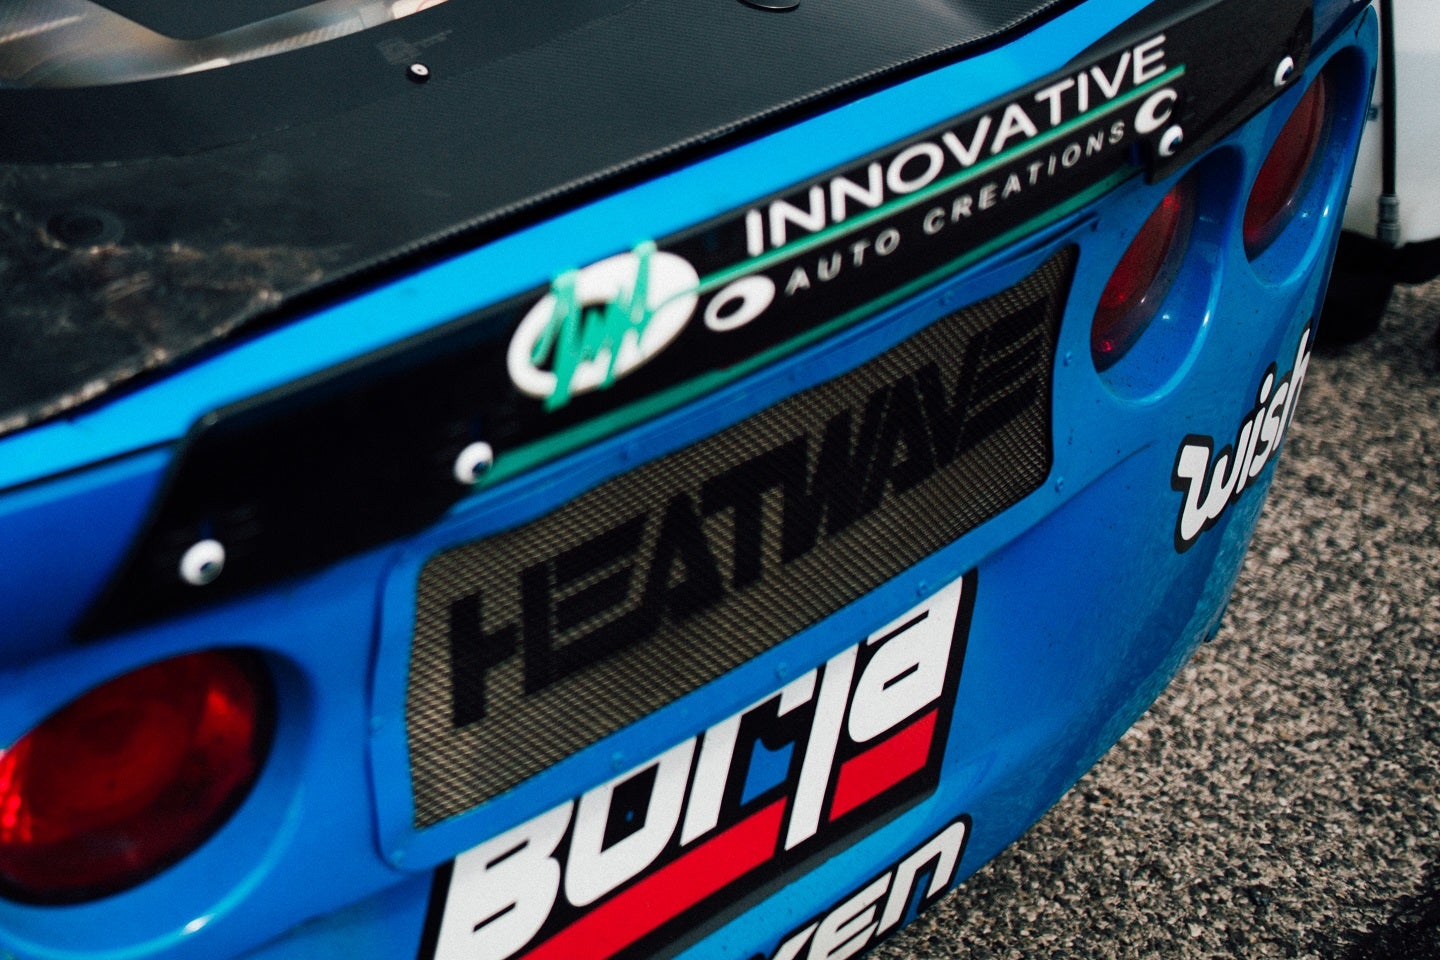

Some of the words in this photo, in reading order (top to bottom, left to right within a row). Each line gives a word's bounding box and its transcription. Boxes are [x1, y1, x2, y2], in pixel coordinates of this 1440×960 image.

[745, 35, 1167, 258] INNOVATIVE
[784, 228, 902, 296] AUTO
[923, 120, 1125, 236] CREATIONS
[450, 293, 1050, 728] HEATWAVE
